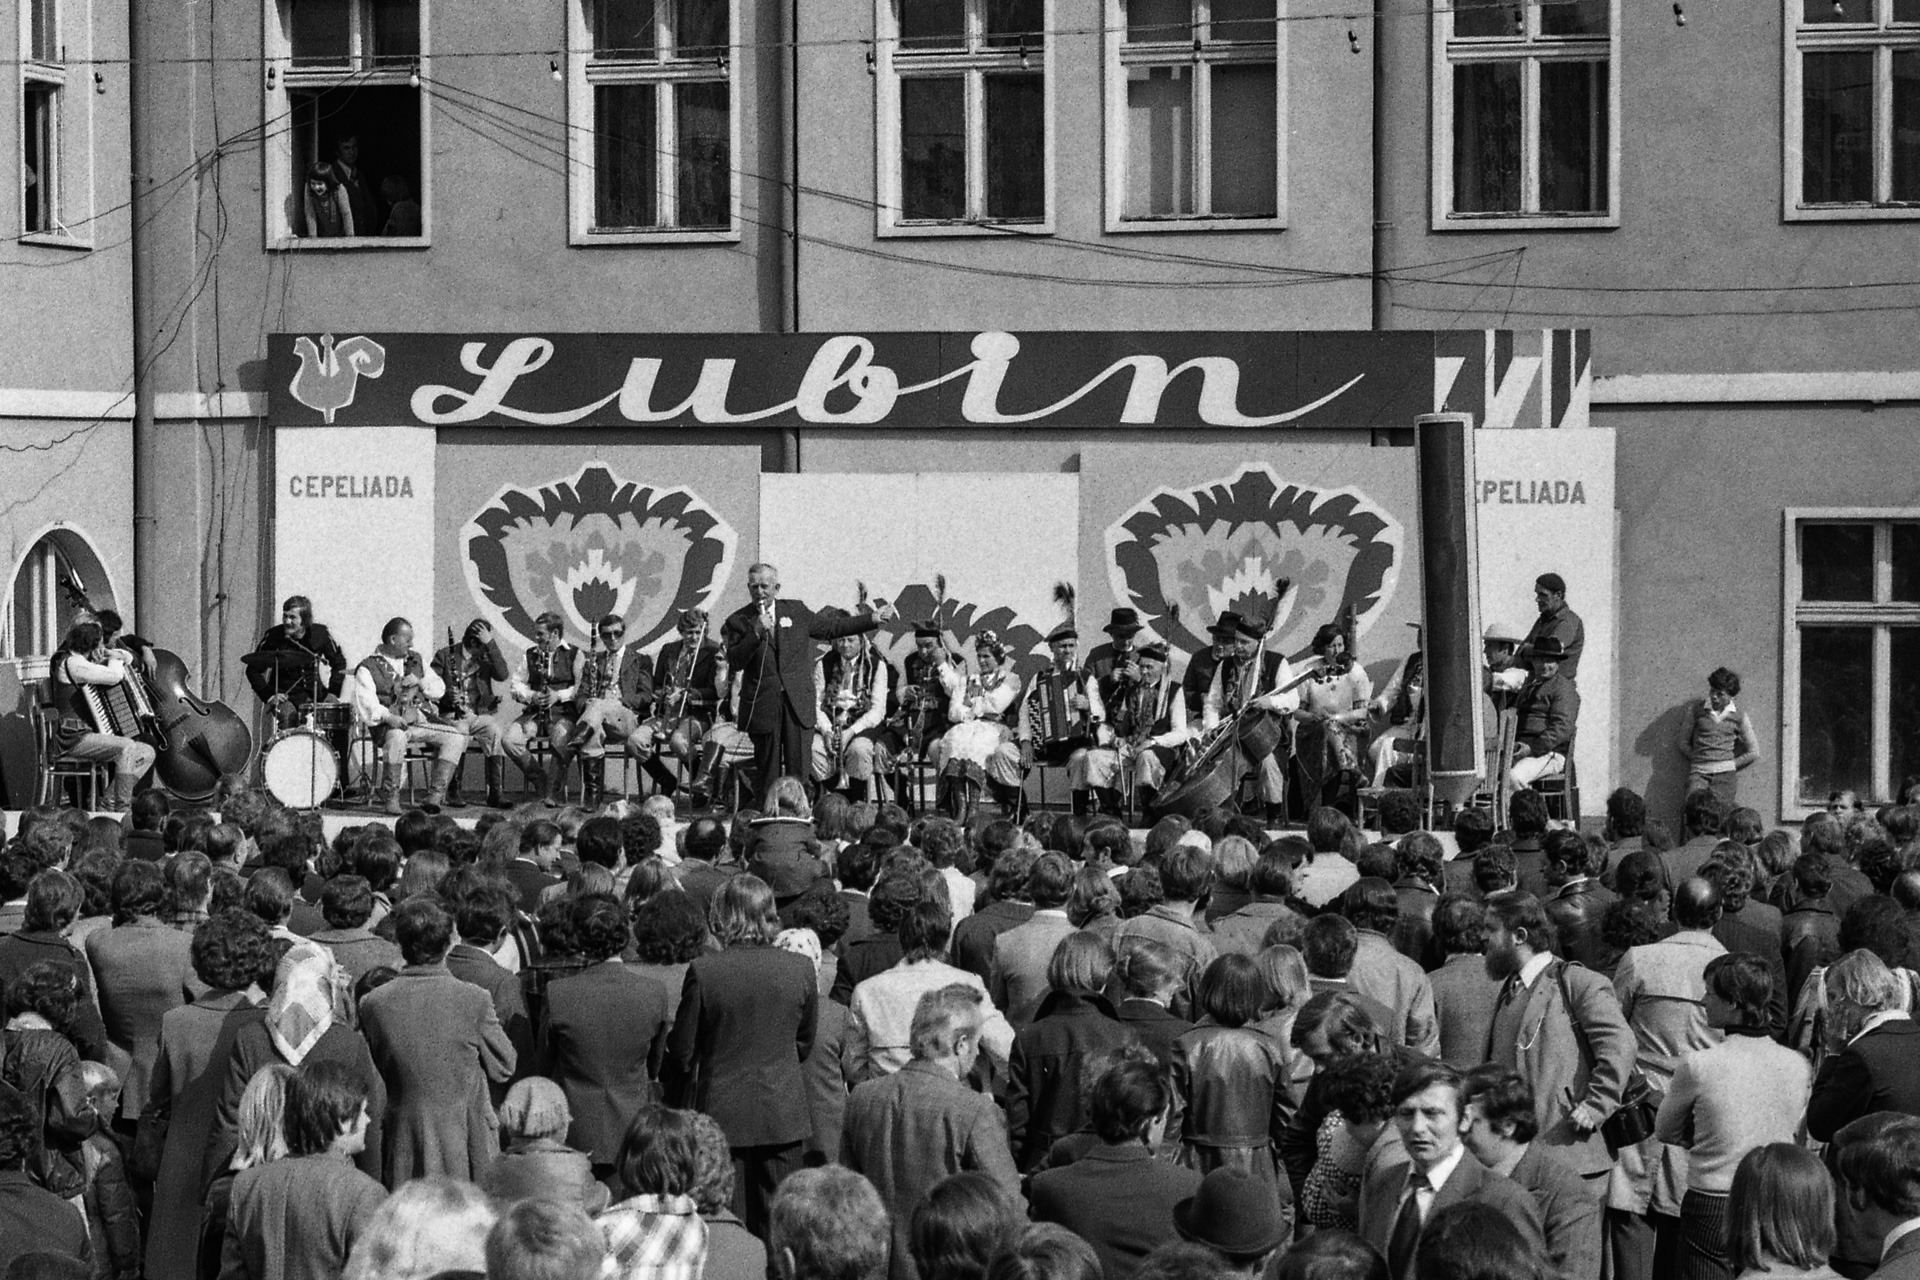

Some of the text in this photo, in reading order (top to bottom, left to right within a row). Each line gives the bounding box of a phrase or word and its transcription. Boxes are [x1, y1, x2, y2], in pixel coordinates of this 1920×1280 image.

[410, 331, 1366, 427] Lubin
[289, 475, 414, 499] CEPELIADA
[1475, 480, 1586, 505] PELIADA
